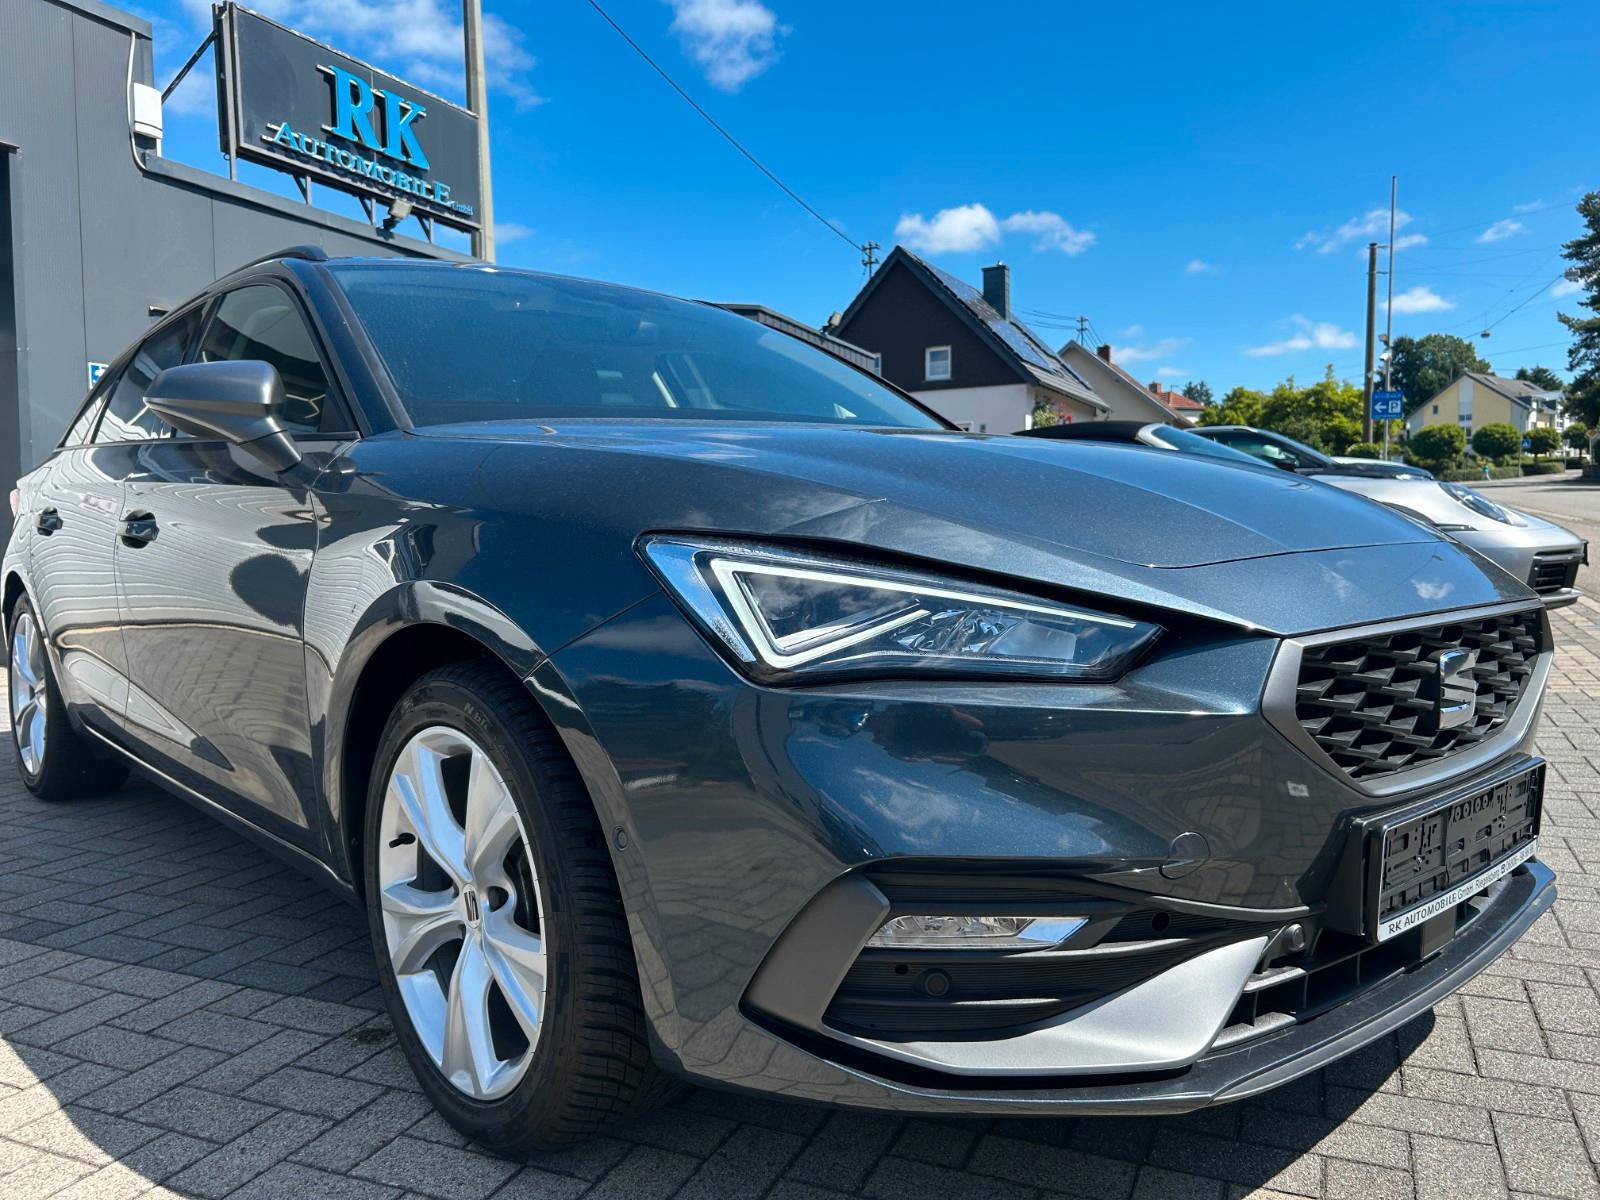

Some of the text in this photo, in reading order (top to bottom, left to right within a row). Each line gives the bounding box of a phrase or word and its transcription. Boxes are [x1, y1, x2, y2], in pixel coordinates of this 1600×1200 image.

[317, 64, 430, 170] RK
[263, 121, 454, 206] AUTOMOBILE
[1388, 919, 1402, 935] RK
[1404, 892, 1457, 928] AUTOMOBILE
[1457, 883, 1474, 900] GmbH
